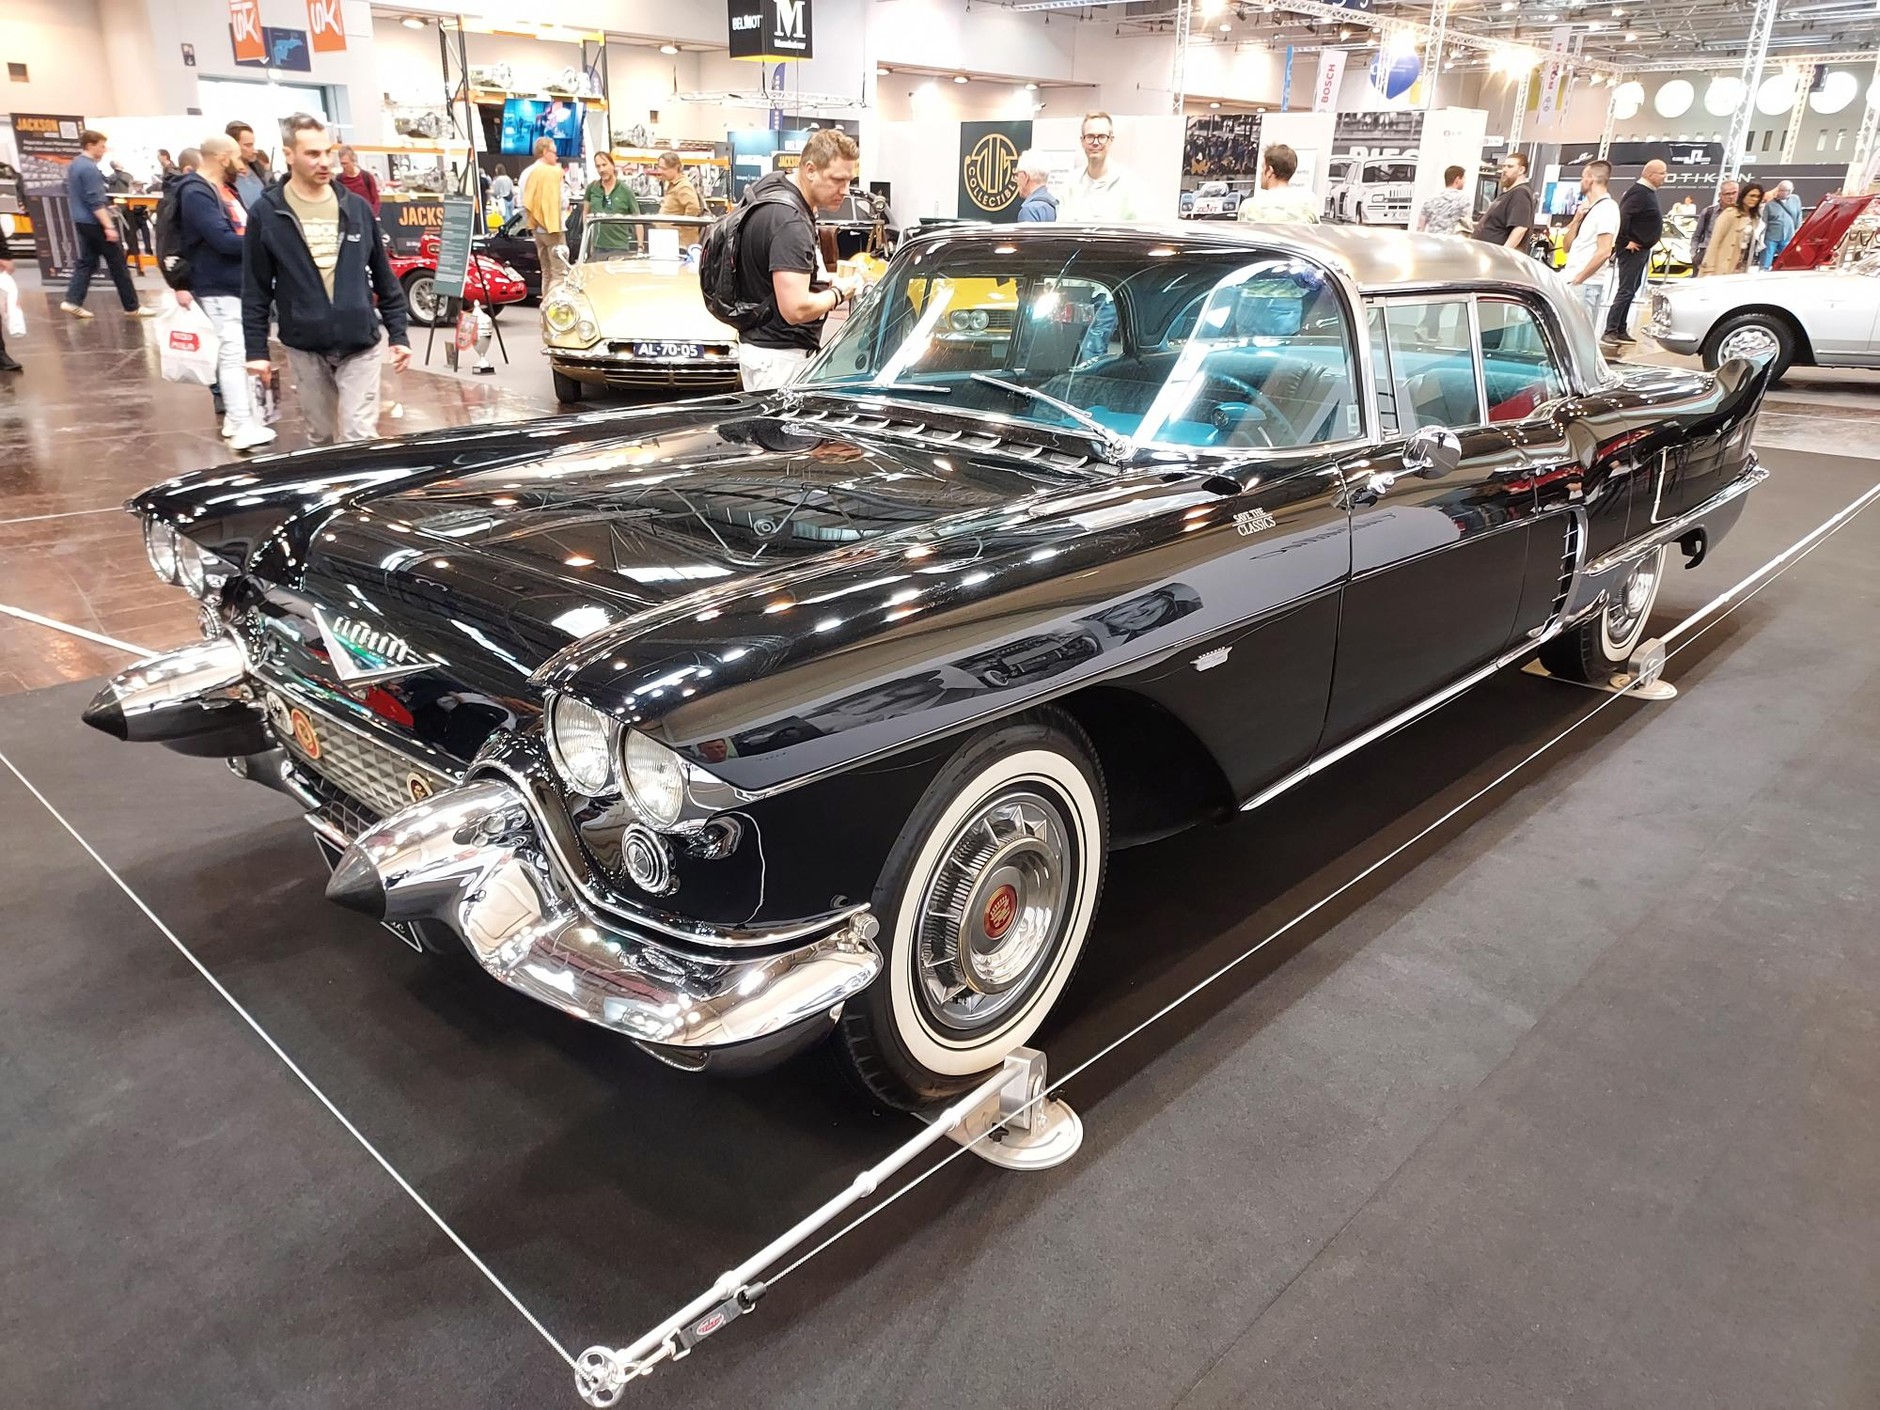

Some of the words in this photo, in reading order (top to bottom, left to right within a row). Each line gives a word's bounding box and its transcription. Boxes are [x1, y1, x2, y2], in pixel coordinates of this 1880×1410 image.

[1321, 63, 1337, 104] BOSCH
[16, 117, 59, 132] JACKSON
[398, 206, 445, 226] JACKS
[637, 343, 699, 357] AL-70-05
[1232, 511, 1253, 523] SAVE
[1249, 507, 1267, 518] THE
[1237, 515, 1277, 537] CLASSICS
